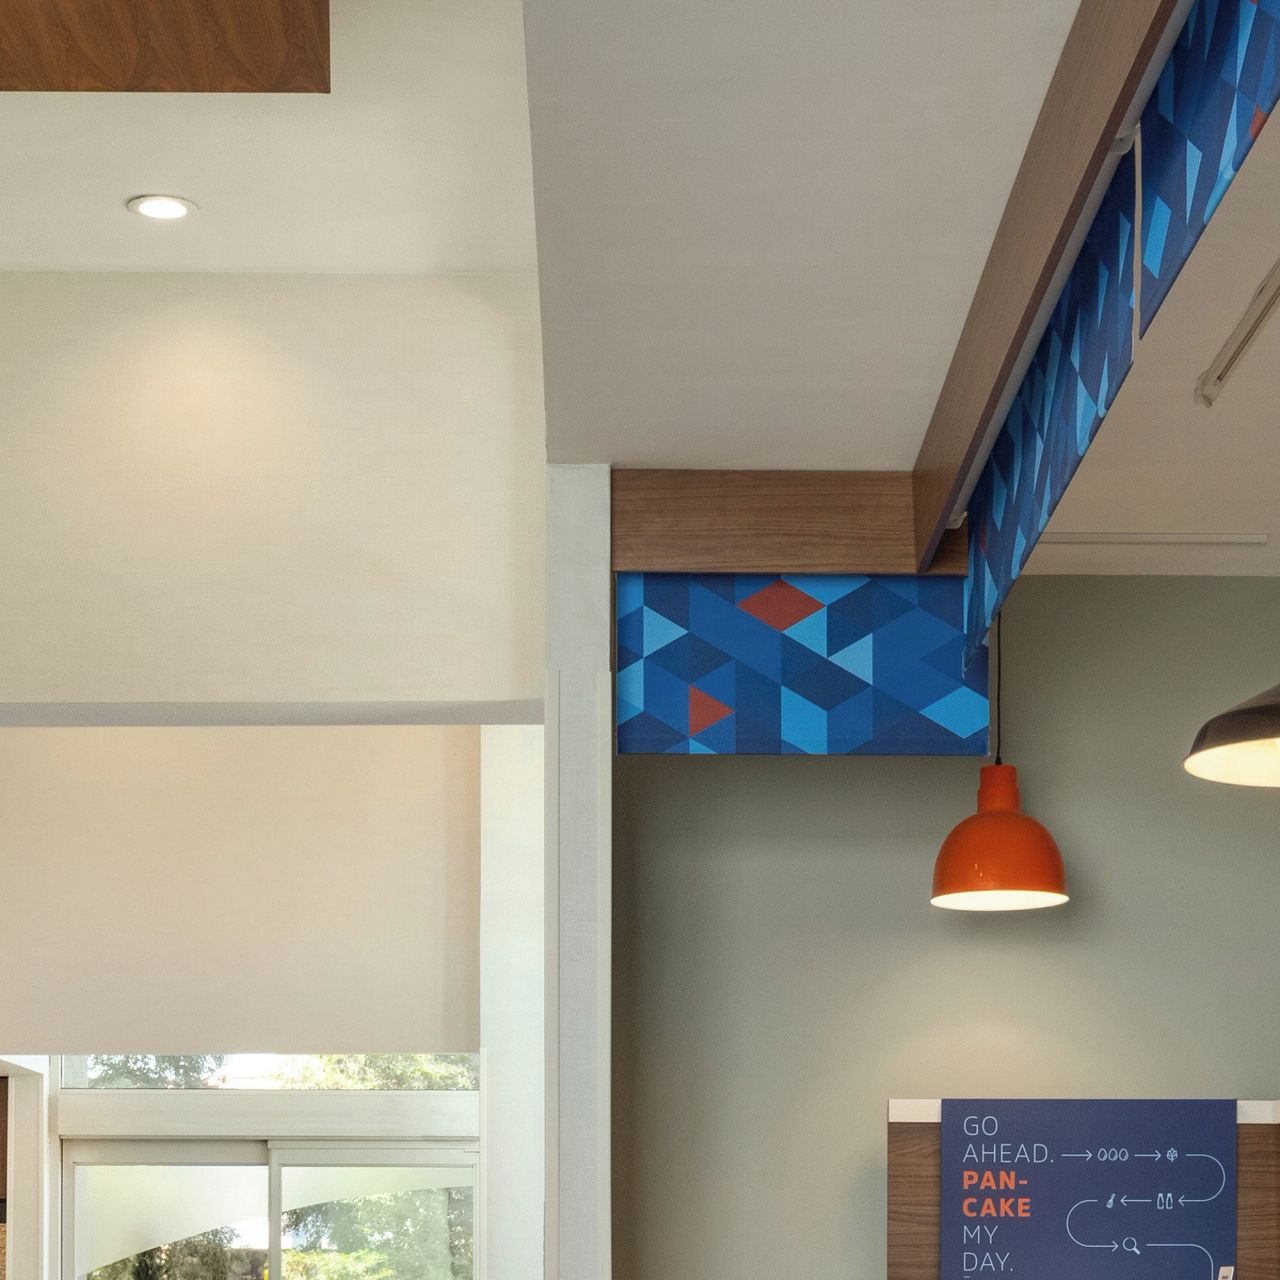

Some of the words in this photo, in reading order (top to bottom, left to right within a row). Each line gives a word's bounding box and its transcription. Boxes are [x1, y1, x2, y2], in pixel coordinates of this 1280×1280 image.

[963, 1115, 999, 1136] GO
[962, 1143, 1055, 1164] AHEAD.
[962, 1170, 1029, 1190] PAN-
[962, 1197, 1032, 1218] CAKE
[962, 1224, 999, 1245] MY
[962, 1252, 1014, 1272] DAY.
